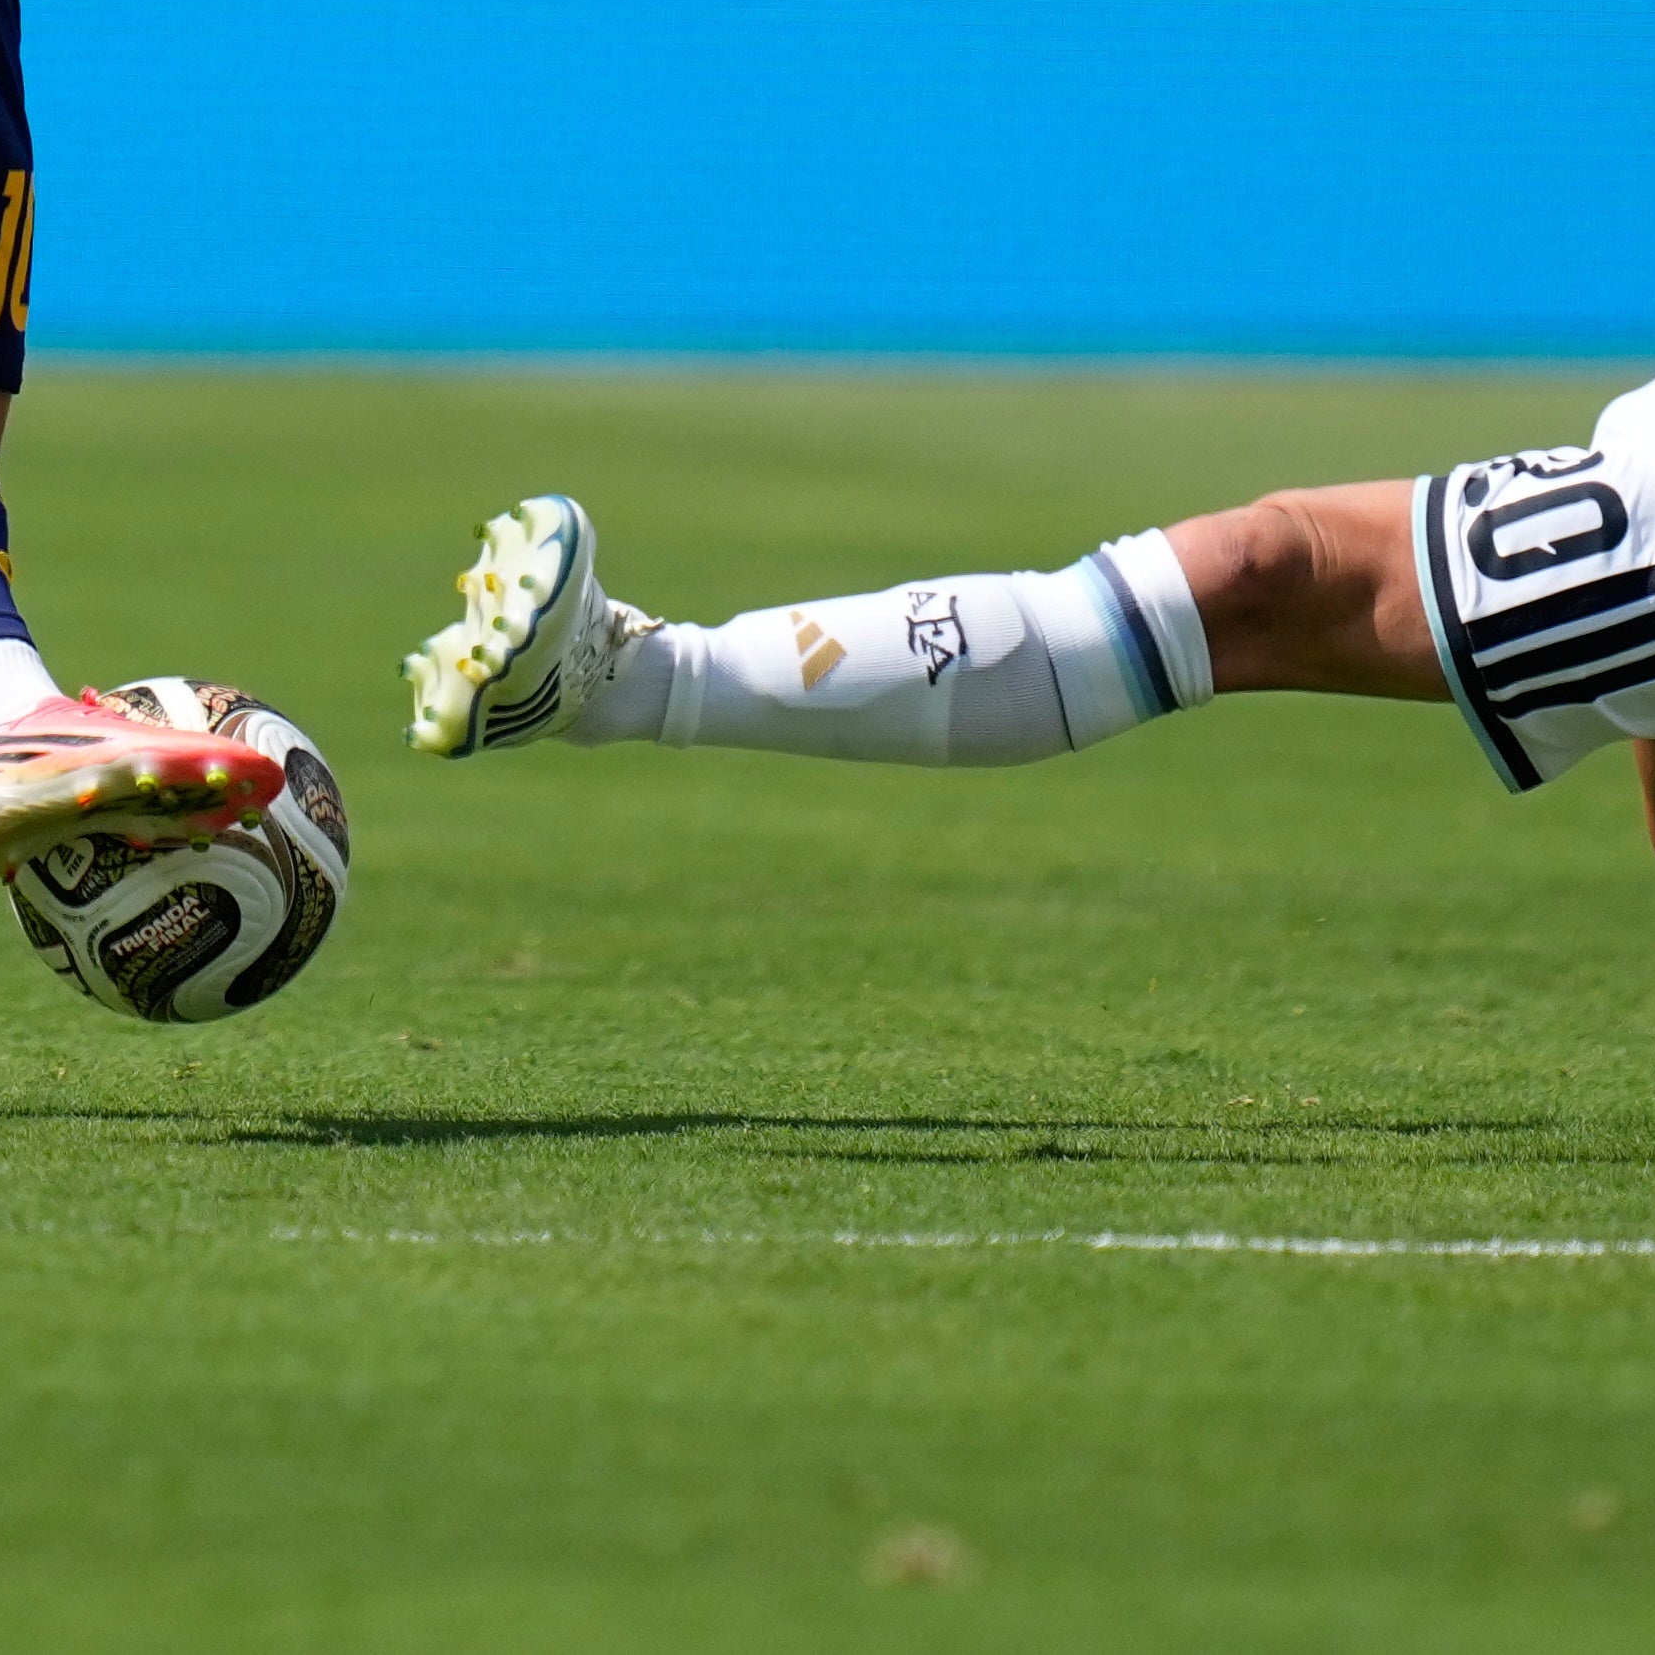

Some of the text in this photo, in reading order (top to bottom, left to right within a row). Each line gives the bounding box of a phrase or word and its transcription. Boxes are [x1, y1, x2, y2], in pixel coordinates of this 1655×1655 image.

[906, 591, 967, 687] AFA
[67, 853, 86, 878] FIFA
[110, 896, 201, 956] TRIONDA
[148, 907, 210, 952] FINAL
